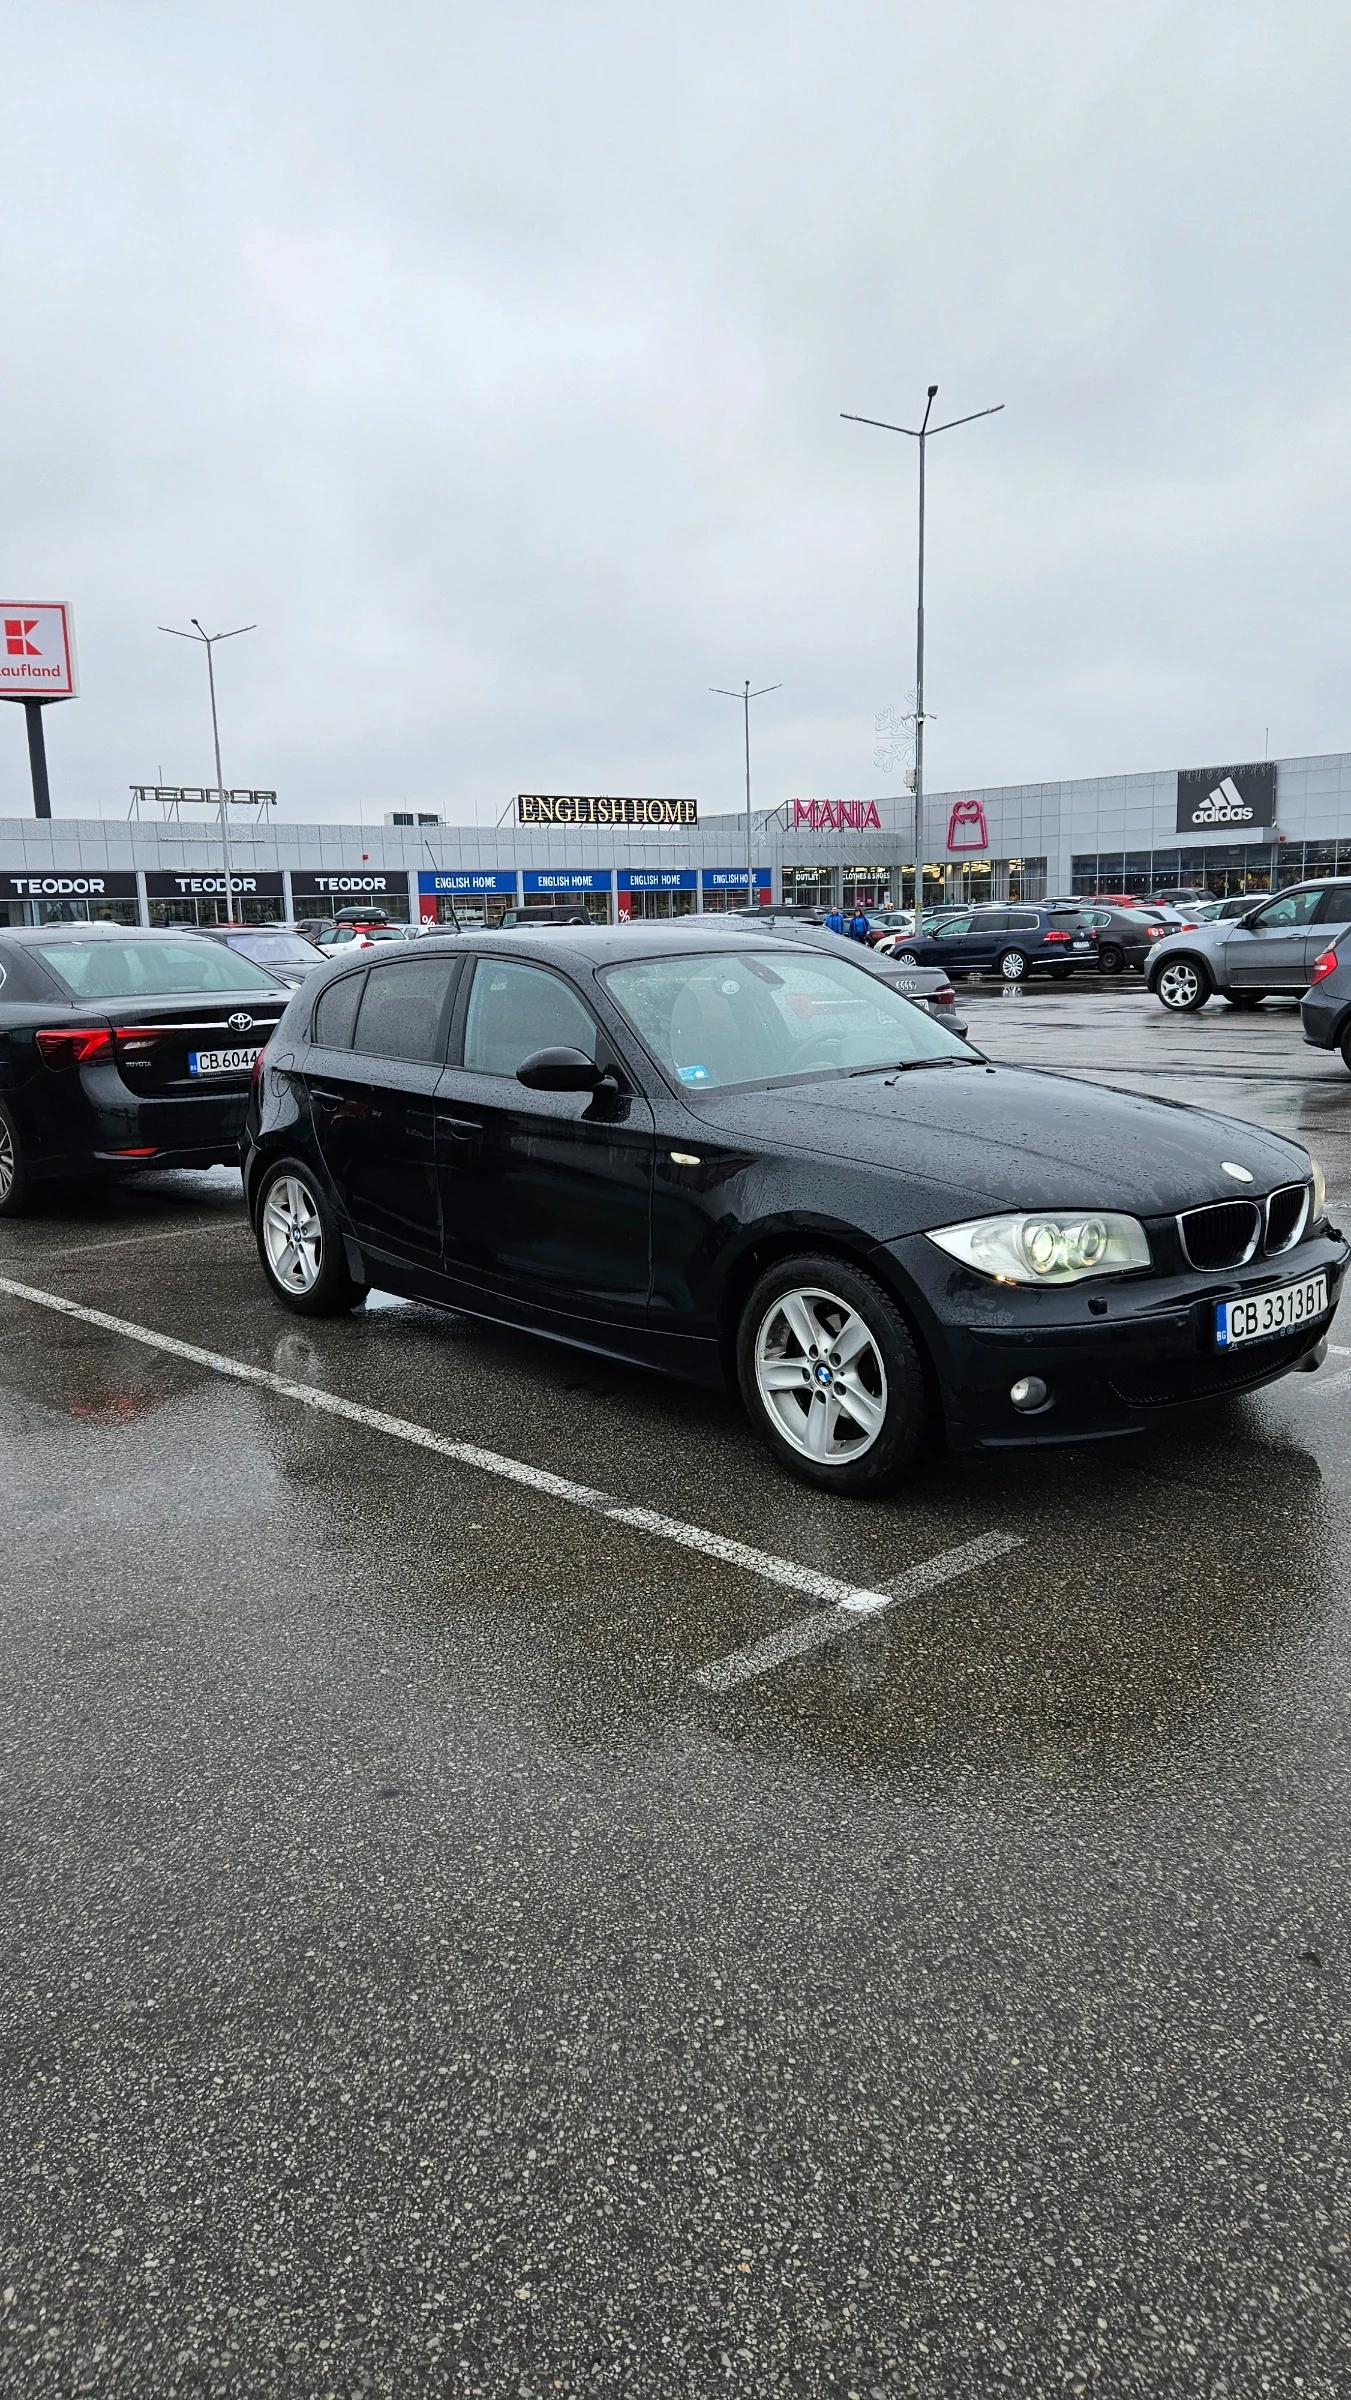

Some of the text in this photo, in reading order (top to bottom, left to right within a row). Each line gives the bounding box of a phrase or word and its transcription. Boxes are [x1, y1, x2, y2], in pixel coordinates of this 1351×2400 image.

[0, 664, 61, 677] aufland
[129, 785, 277, 805] TEODOR
[520, 796, 697, 823] ENGLISH HOME
[793, 798, 881, 828] MANIA
[1191, 804, 1254, 824] adidas
[315, 877, 387, 890] TEODOR
[435, 876, 496, 888] ENGLISH HOME
[538, 875, 593, 887] ENGLISH HOME
[630, 874, 681, 885] ENGLISH HOME
[713, 874, 738, 884] ENGLISH
[796, 873, 819, 881] OUTLET
[10, 878, 105, 894] TEODOR
[175, 878, 257, 892] TEODOR
[1231, 1302, 1258, 1338] CB
[1216, 1330, 1227, 1342] BG
